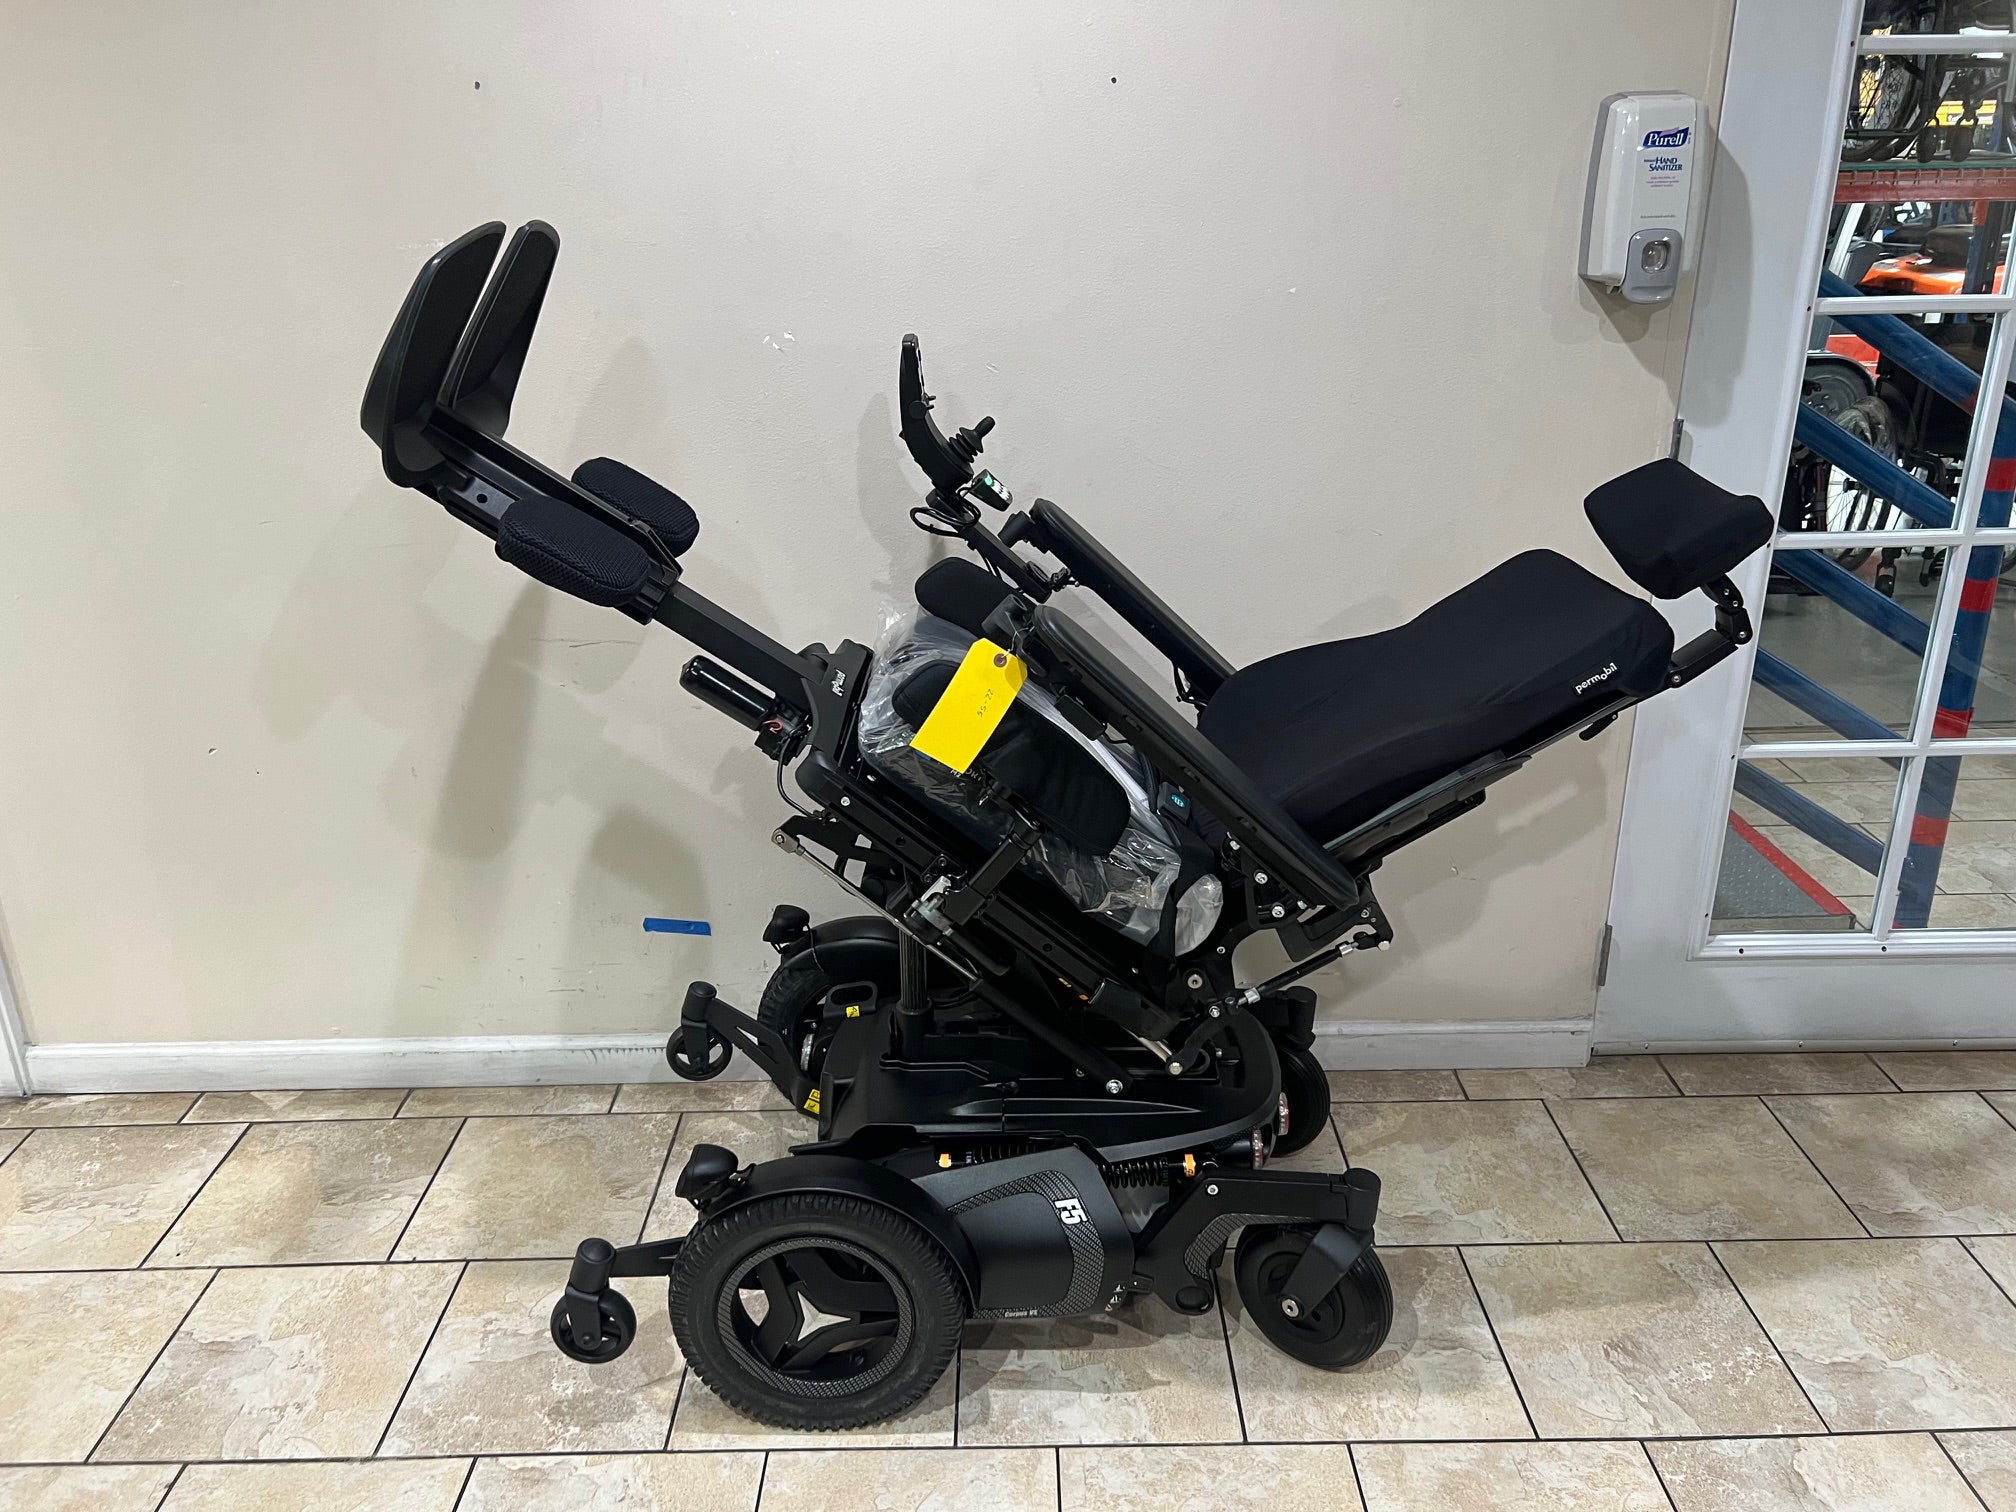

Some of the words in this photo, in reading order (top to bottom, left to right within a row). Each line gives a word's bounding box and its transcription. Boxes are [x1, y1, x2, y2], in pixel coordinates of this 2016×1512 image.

[1647, 132, 1685, 146] Purell
[1648, 163, 1683, 172] SANITIZER
[1655, 156, 1678, 165] HAND
[1574, 662, 1618, 695] permobil
[1054, 1197, 1089, 1225] F5
